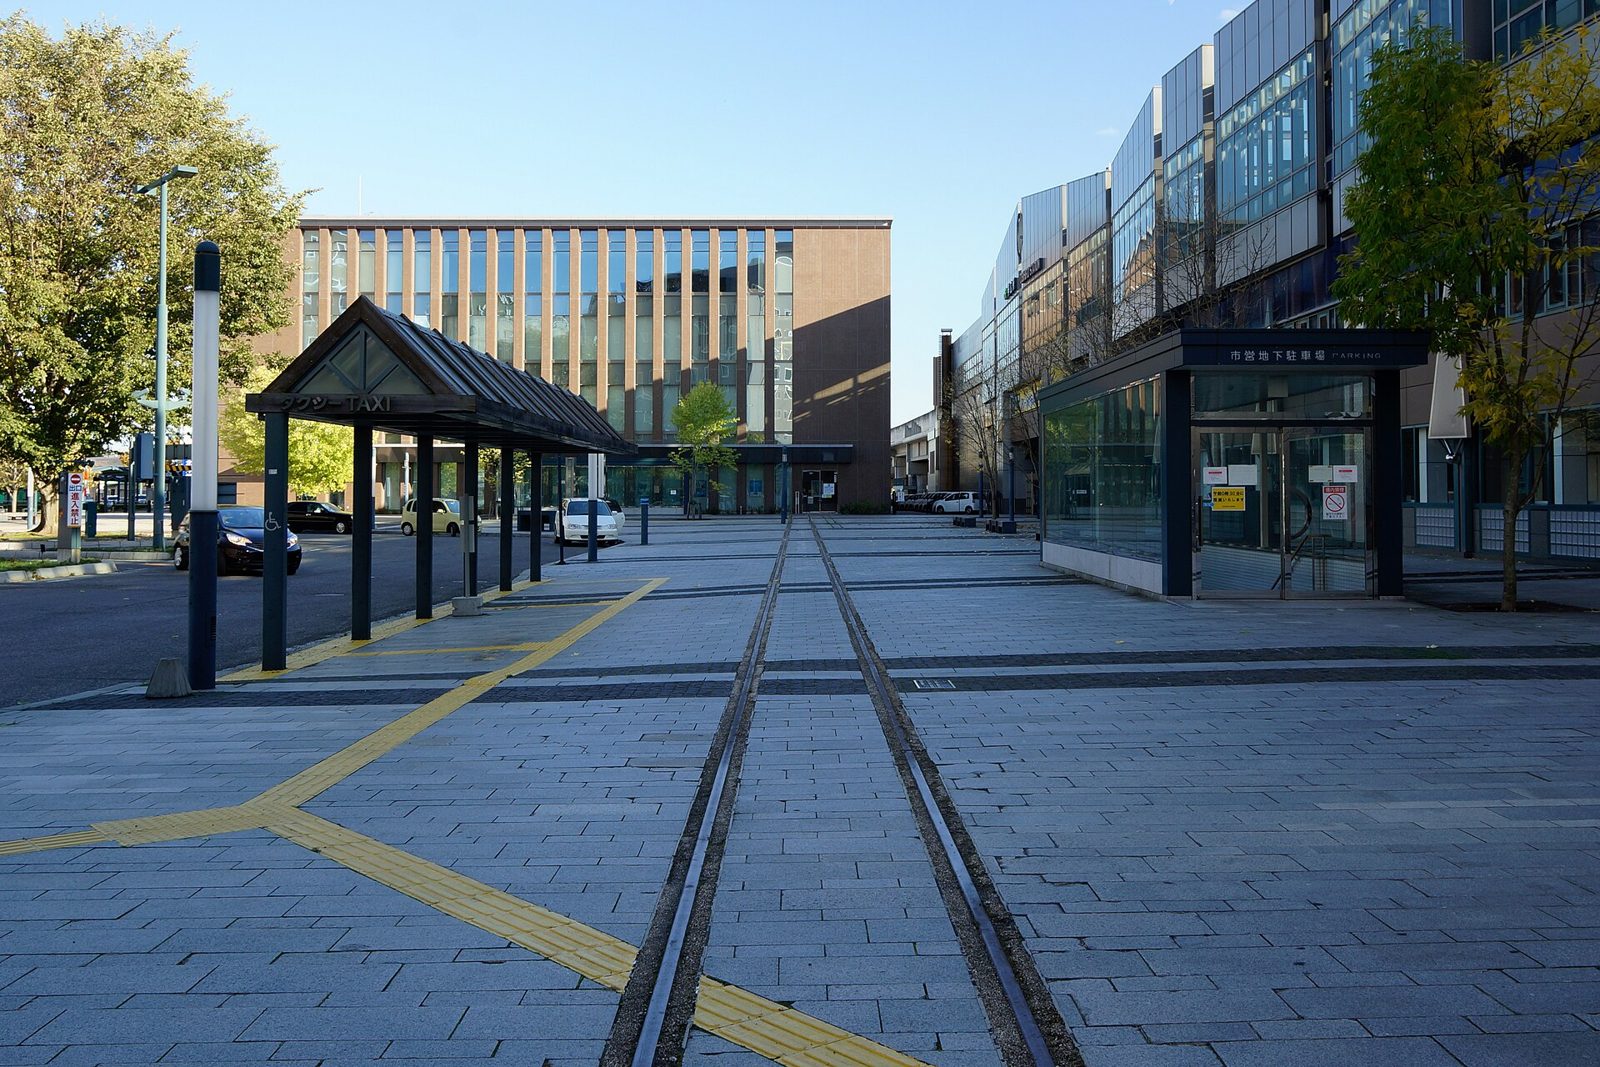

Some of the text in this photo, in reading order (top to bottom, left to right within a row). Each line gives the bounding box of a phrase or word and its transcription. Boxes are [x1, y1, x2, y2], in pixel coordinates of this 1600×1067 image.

[1230, 350, 1381, 361] 市営地下駐車場 PARKING
[281, 394, 391, 412] タクシー TAXI
[71, 493, 80, 525] 進入禁止
